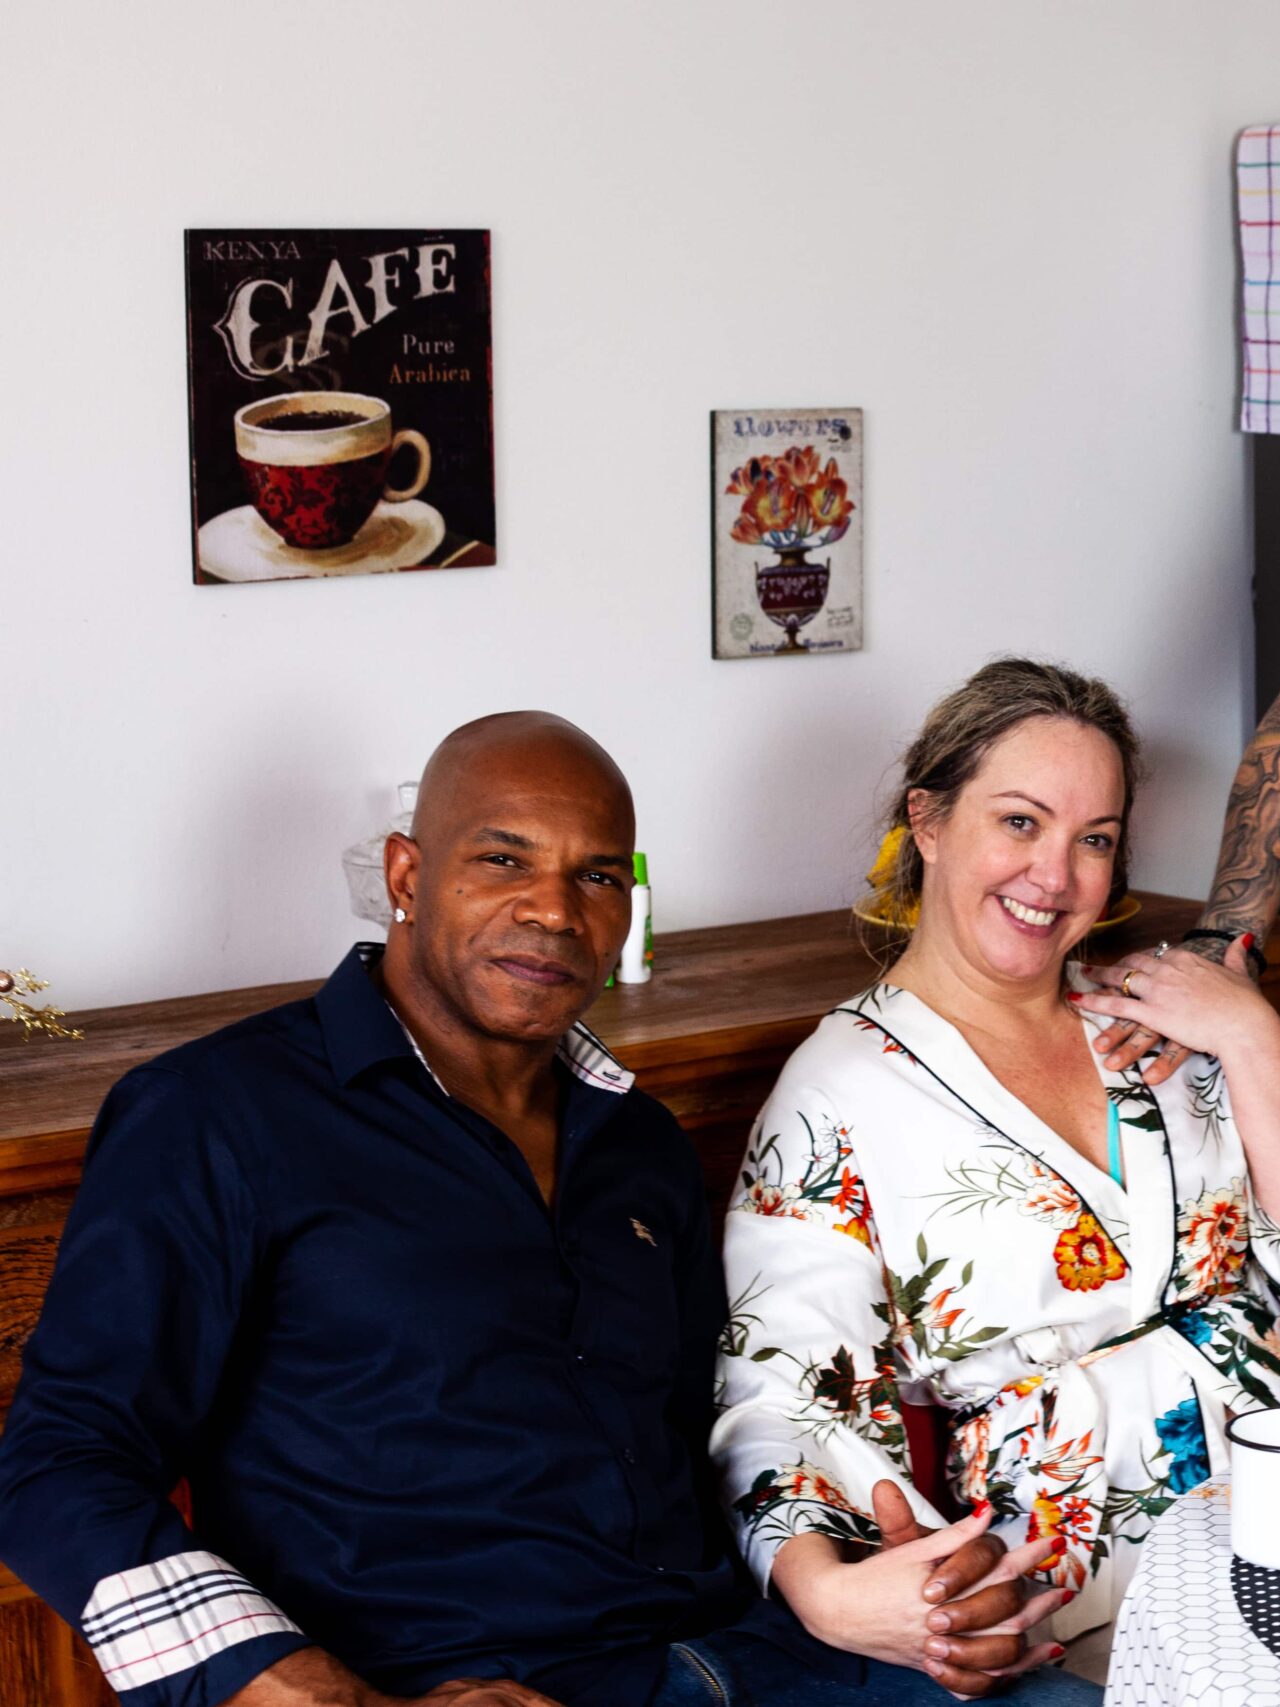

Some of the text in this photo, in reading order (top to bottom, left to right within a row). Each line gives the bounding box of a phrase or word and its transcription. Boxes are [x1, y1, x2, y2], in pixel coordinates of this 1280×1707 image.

[203, 240, 301, 261] KENYA
[402, 334, 455, 354] Pure
[389, 363, 471, 385] Arabica
